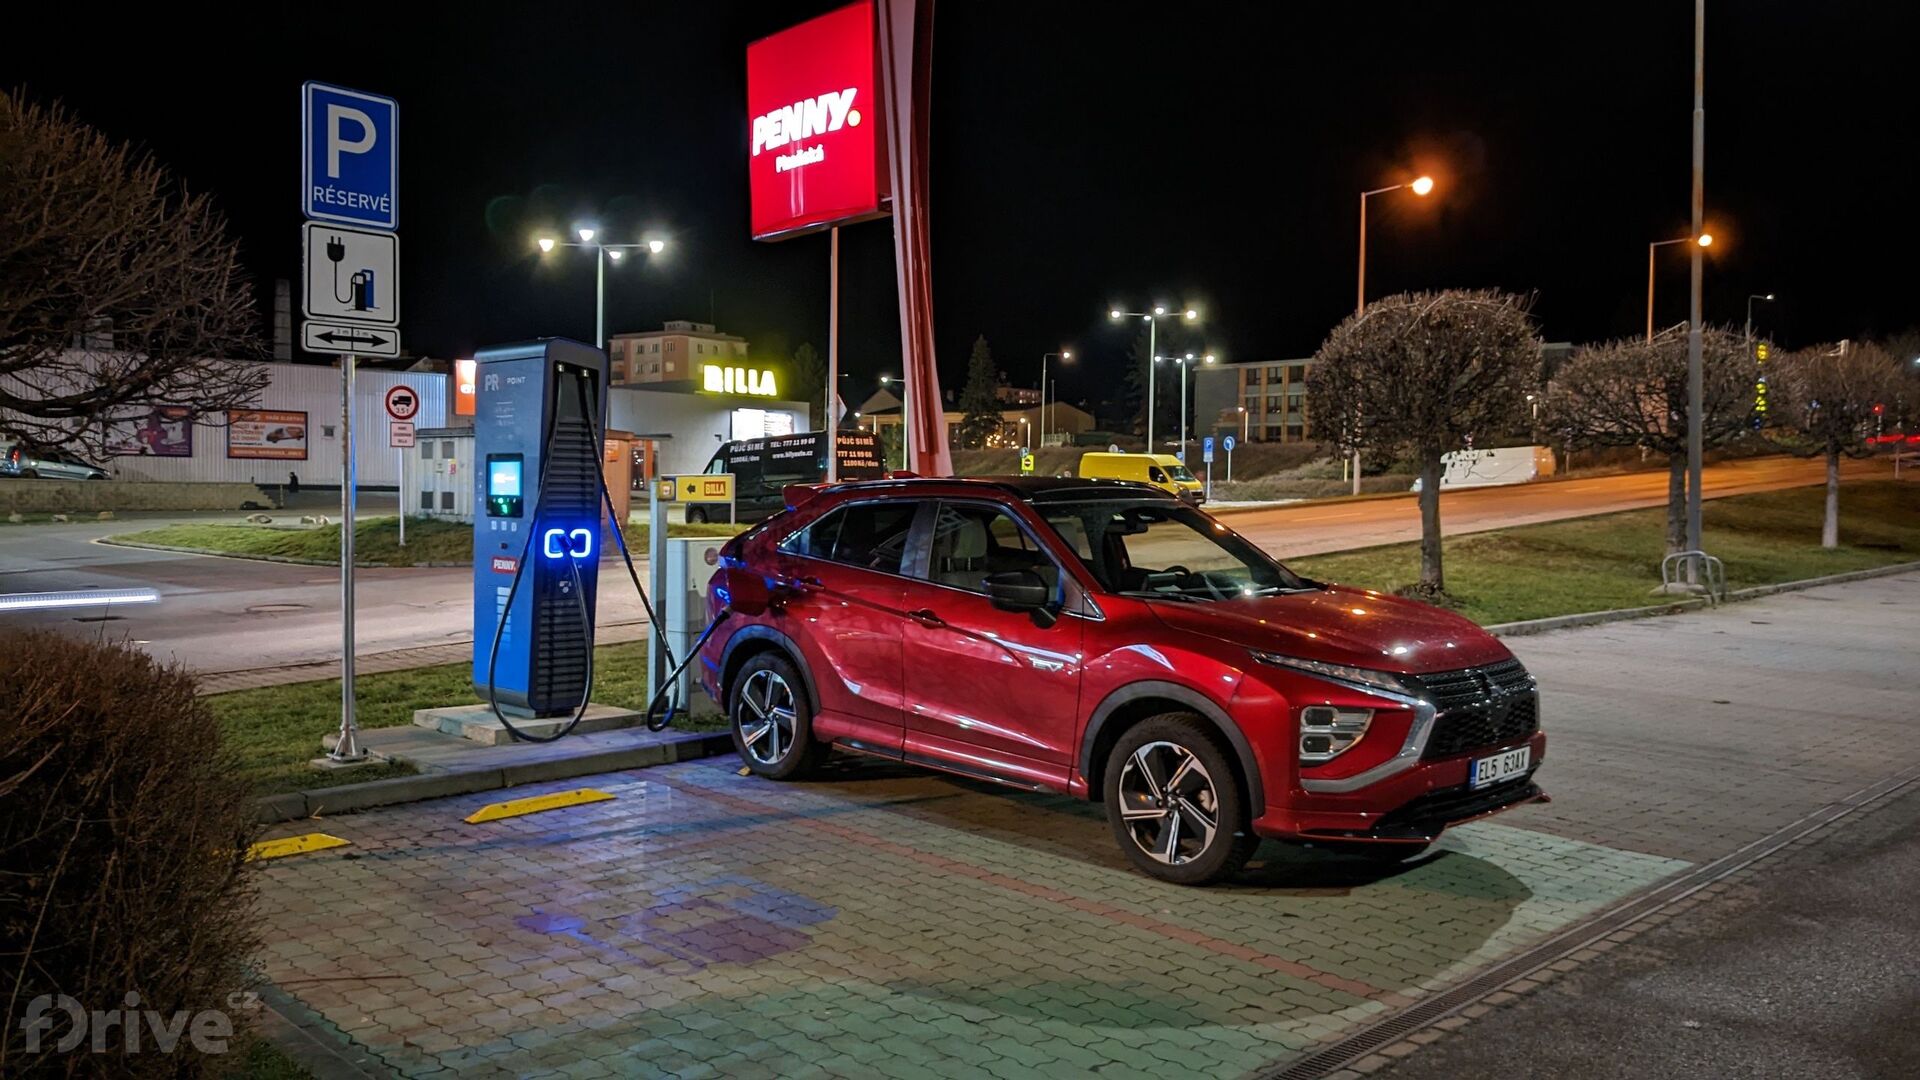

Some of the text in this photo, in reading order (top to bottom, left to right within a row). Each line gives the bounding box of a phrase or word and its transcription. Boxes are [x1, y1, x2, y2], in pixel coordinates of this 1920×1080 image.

[328, 103, 377, 179] P
[313, 184, 390, 213] RÉSERVÉ
[506, 376, 527, 385] POINT
[703, 364, 778, 397] BILLA
[705, 483, 725, 495] BILLA
[1478, 750, 1527, 781] EL5 63AX
